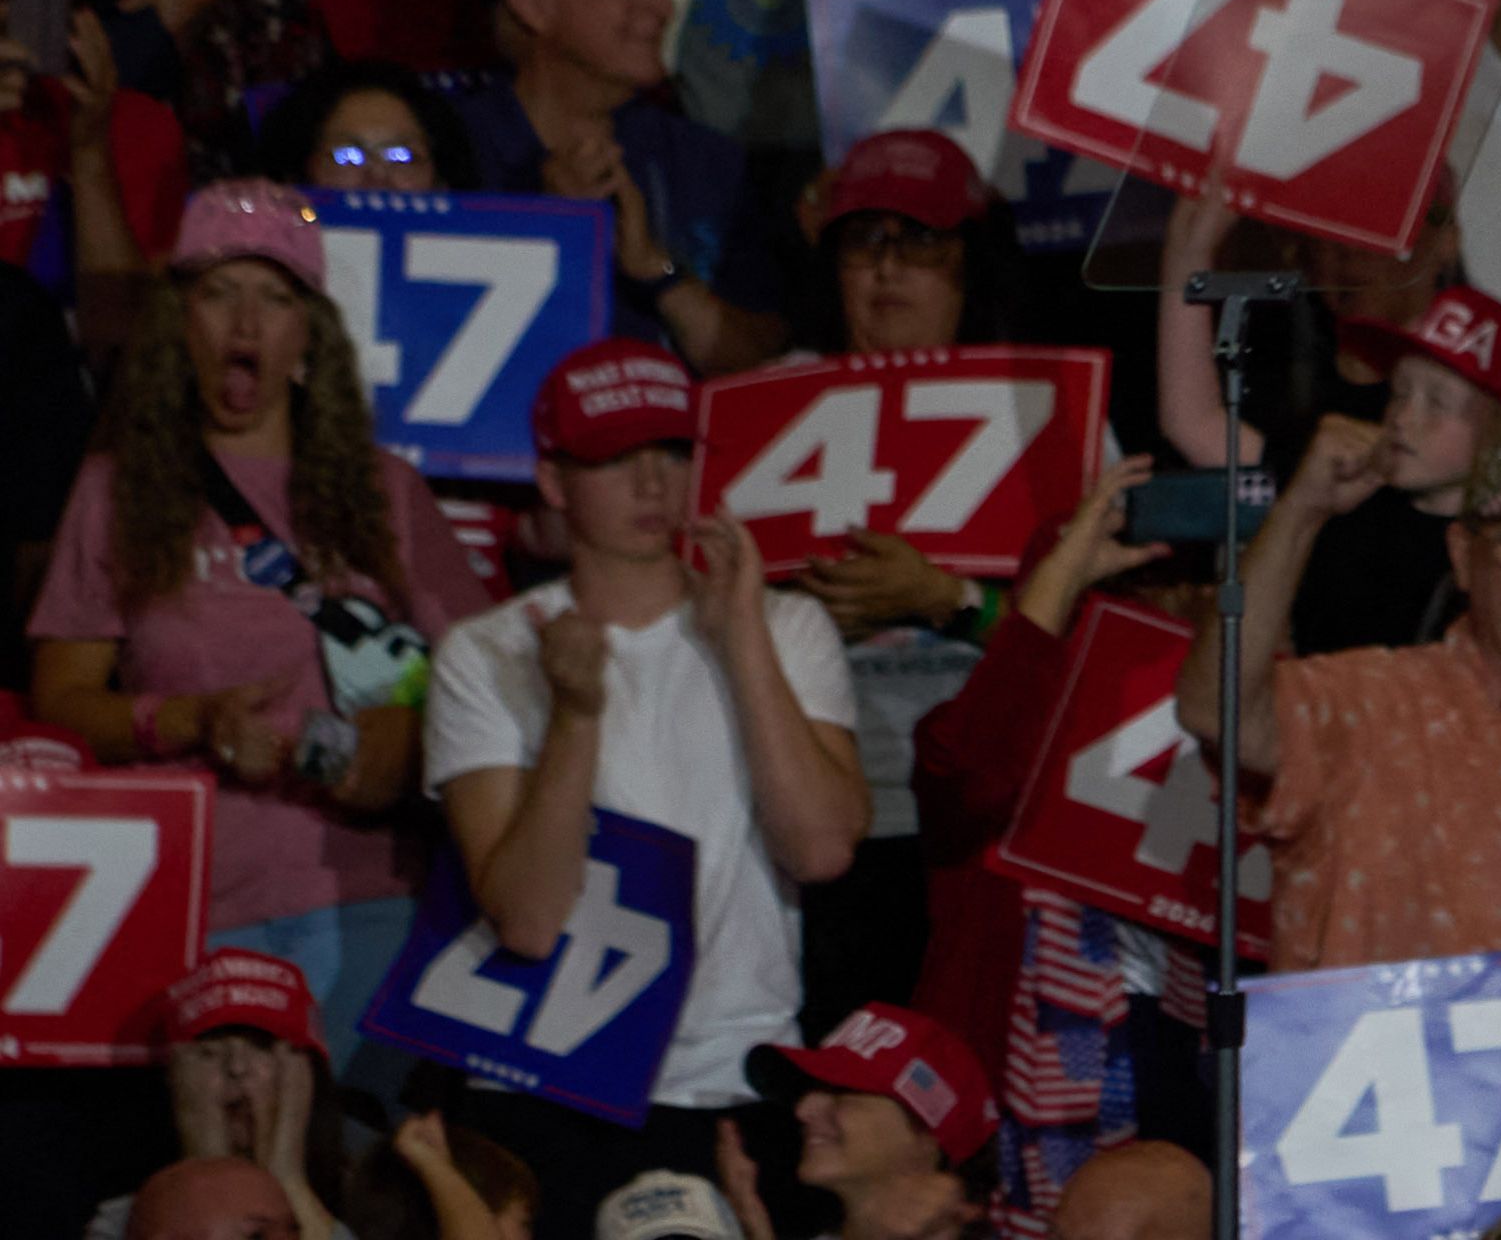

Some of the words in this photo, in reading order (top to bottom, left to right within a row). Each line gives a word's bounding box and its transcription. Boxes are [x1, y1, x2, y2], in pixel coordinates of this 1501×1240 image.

[723, 378, 1058, 538] 47
[0, 817, 160, 1015] 7
[410, 857, 673, 1058] 47
